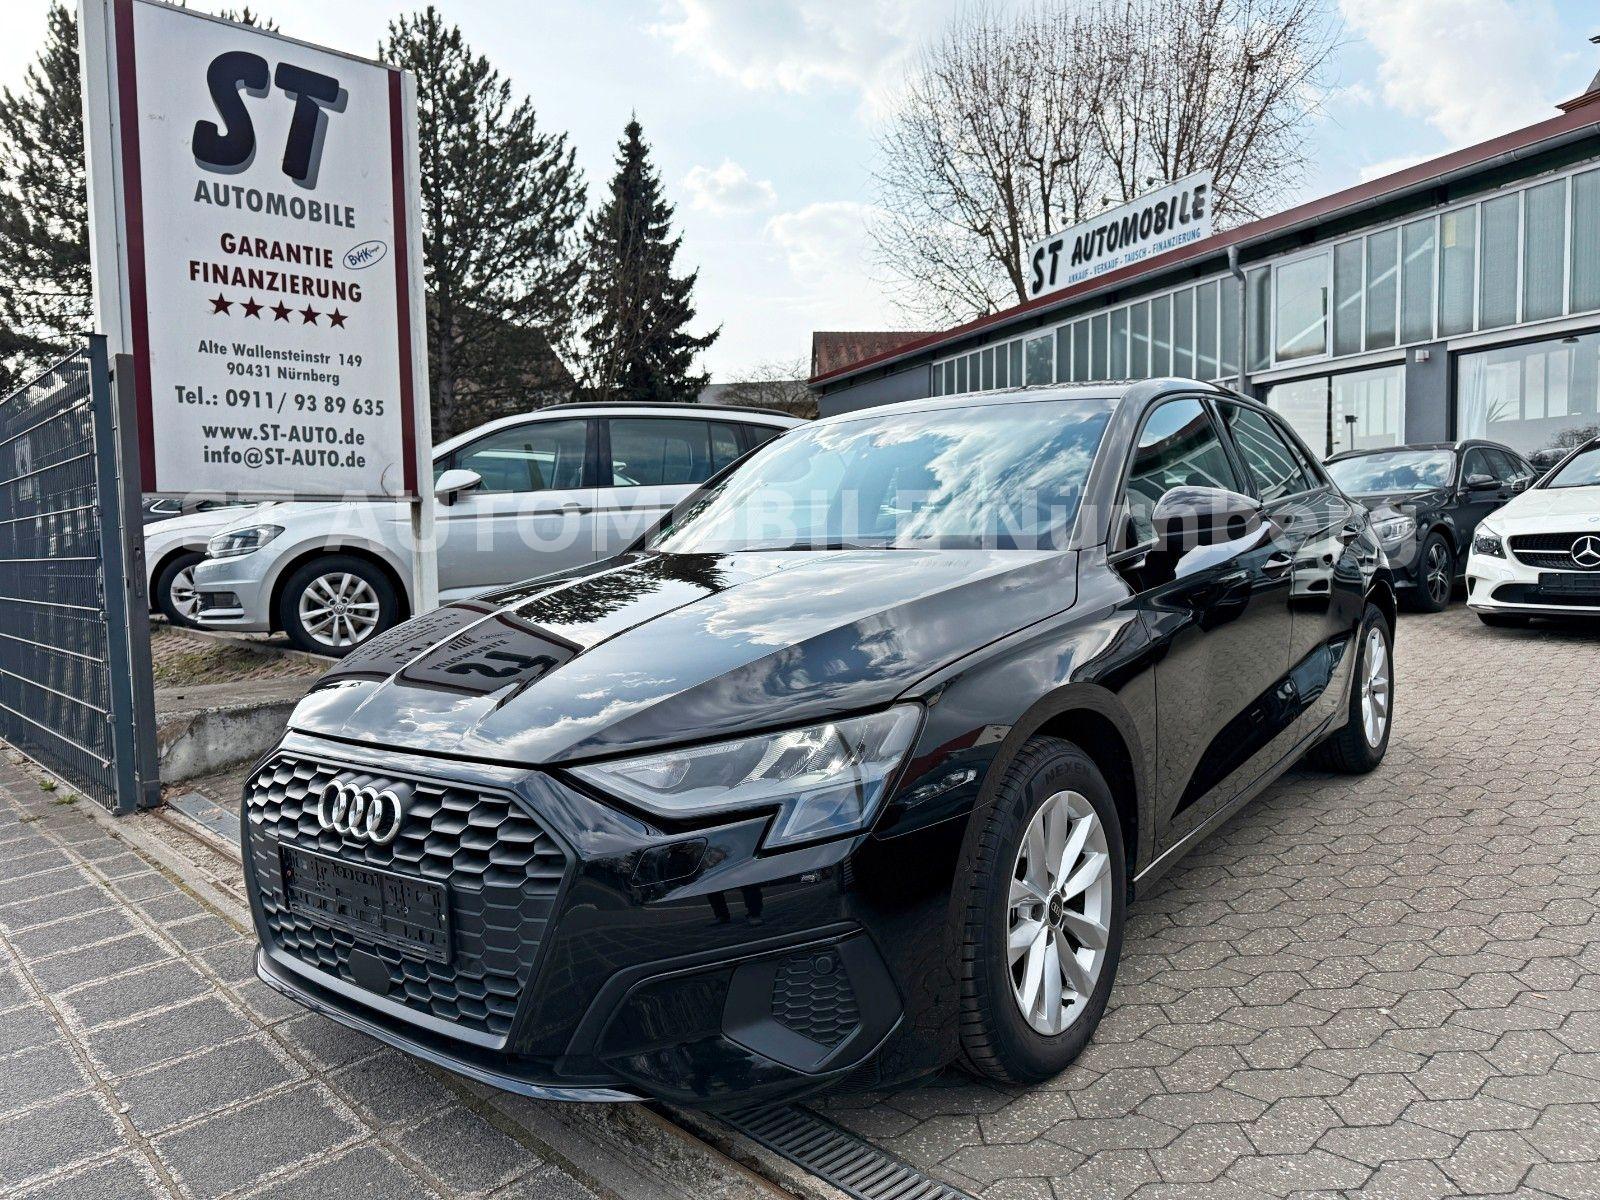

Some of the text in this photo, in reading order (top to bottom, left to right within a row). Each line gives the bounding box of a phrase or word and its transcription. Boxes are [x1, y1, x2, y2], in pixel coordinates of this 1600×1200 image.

[192, 51, 348, 190] ST
[194, 180, 355, 228] AUTOMOBILE
[220, 233, 333, 269] GARANTIE
[1033, 184, 1207, 294] ST AUTOMOBILE
[1094, 258, 1119, 275] VERKAUF
[1125, 248, 1147, 264] TAUSCH
[1152, 227, 1201, 255] FINANZIERUNG
[189, 260, 363, 302] FINANZIERUNG
[198, 340, 363, 367] Alte Wallensteinstr 149
[226, 362, 340, 386] 90431 Nürnberg
[175, 385, 218, 406] Tel.:
[294, 394, 318, 412] 93
[324, 396, 346, 415] 89
[352, 398, 384, 416] 635
[202, 423, 365, 445] www.ST-AUTO.de
[203, 445, 366, 469] info@ST-AUTO.de
